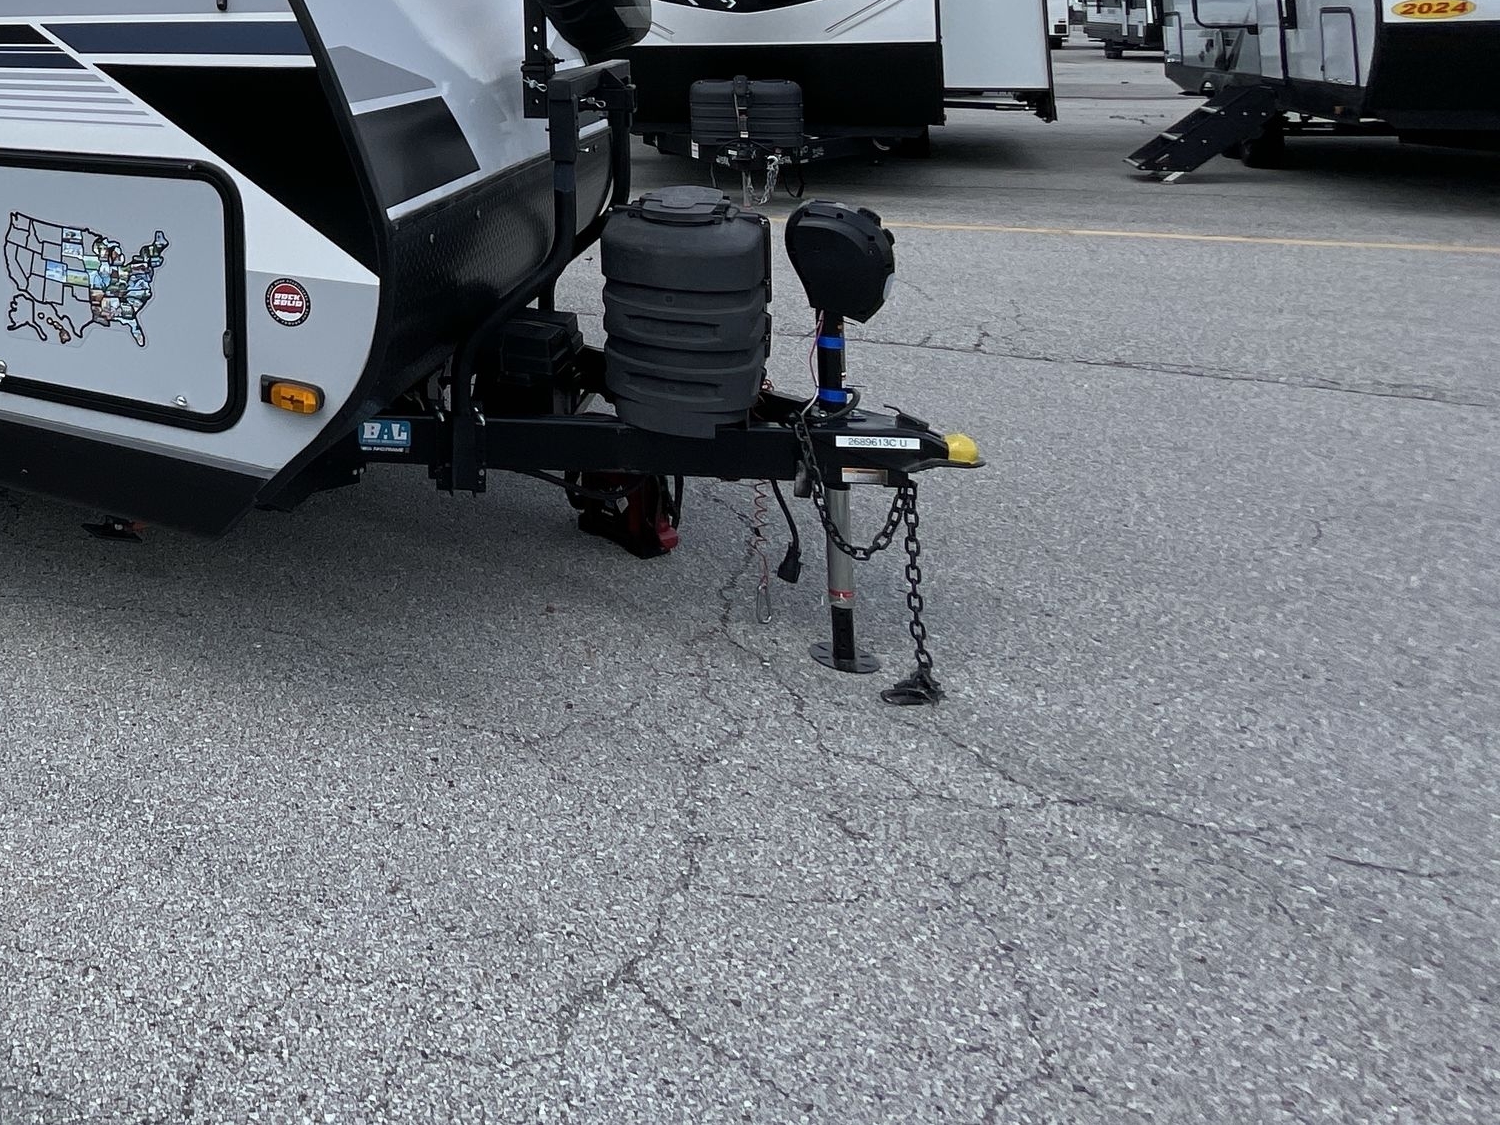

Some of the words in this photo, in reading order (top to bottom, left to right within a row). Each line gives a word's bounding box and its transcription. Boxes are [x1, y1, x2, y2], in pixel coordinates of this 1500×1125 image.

[1400, 1, 1467, 15] 2024
[274, 293, 301, 301] ROCK
[273, 299, 303, 307] SOLID
[363, 422, 408, 440] BAL
[848, 437, 897, 448] 2689613C
